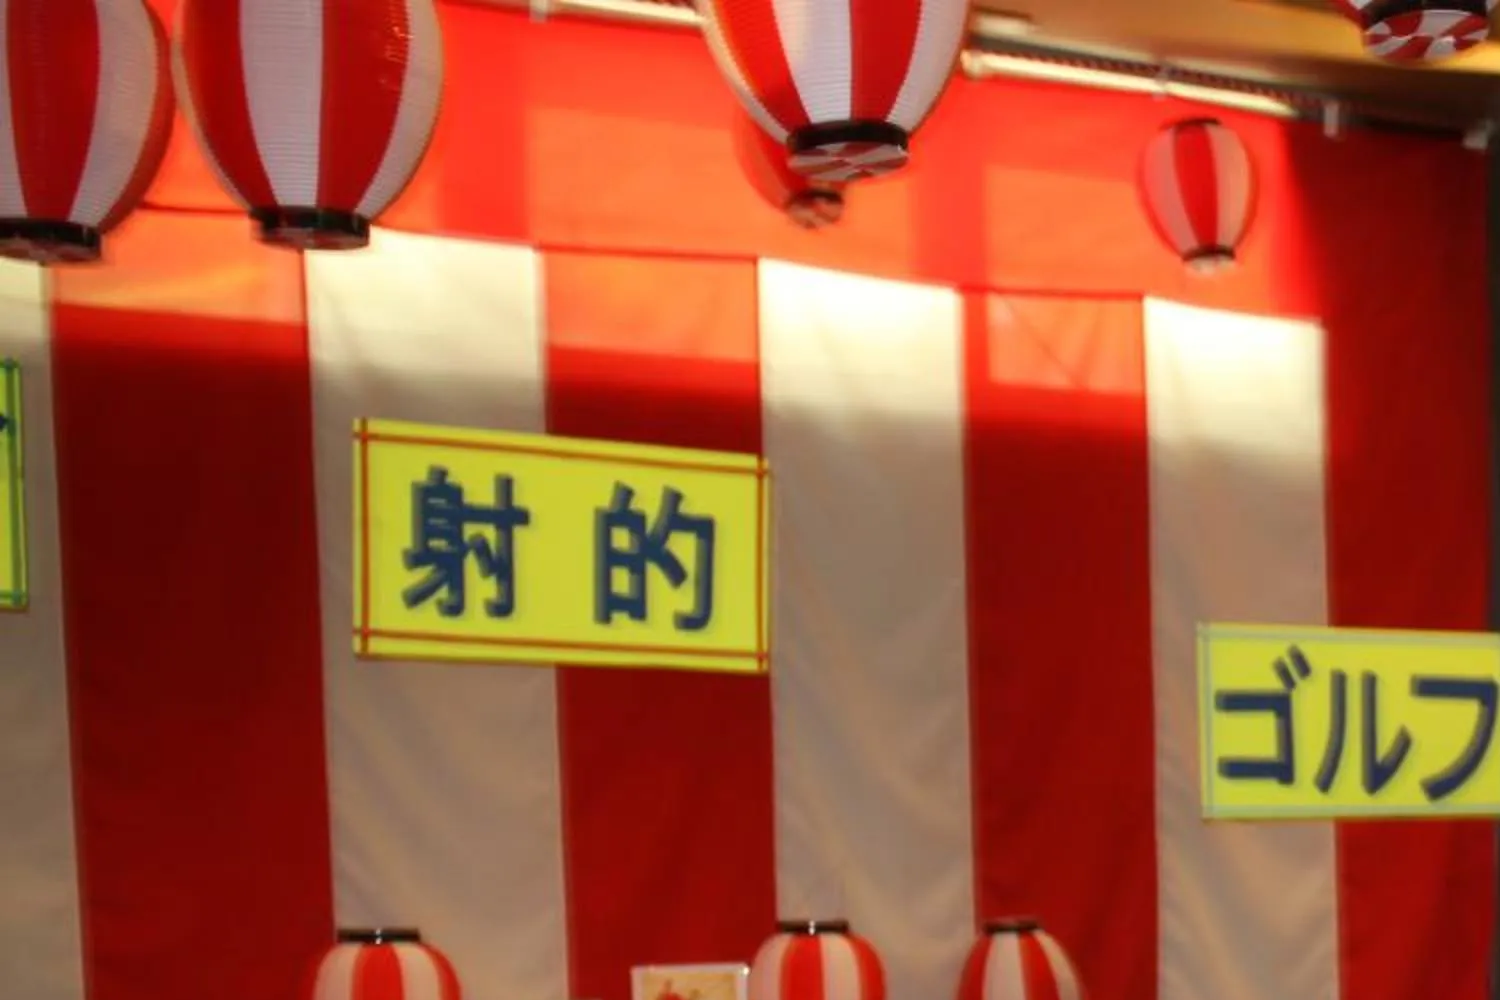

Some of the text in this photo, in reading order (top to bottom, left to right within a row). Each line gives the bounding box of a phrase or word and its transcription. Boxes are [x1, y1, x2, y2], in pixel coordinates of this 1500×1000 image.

[401, 464, 716, 631] 射的
[1214, 644, 1499, 803] ゴルフ
